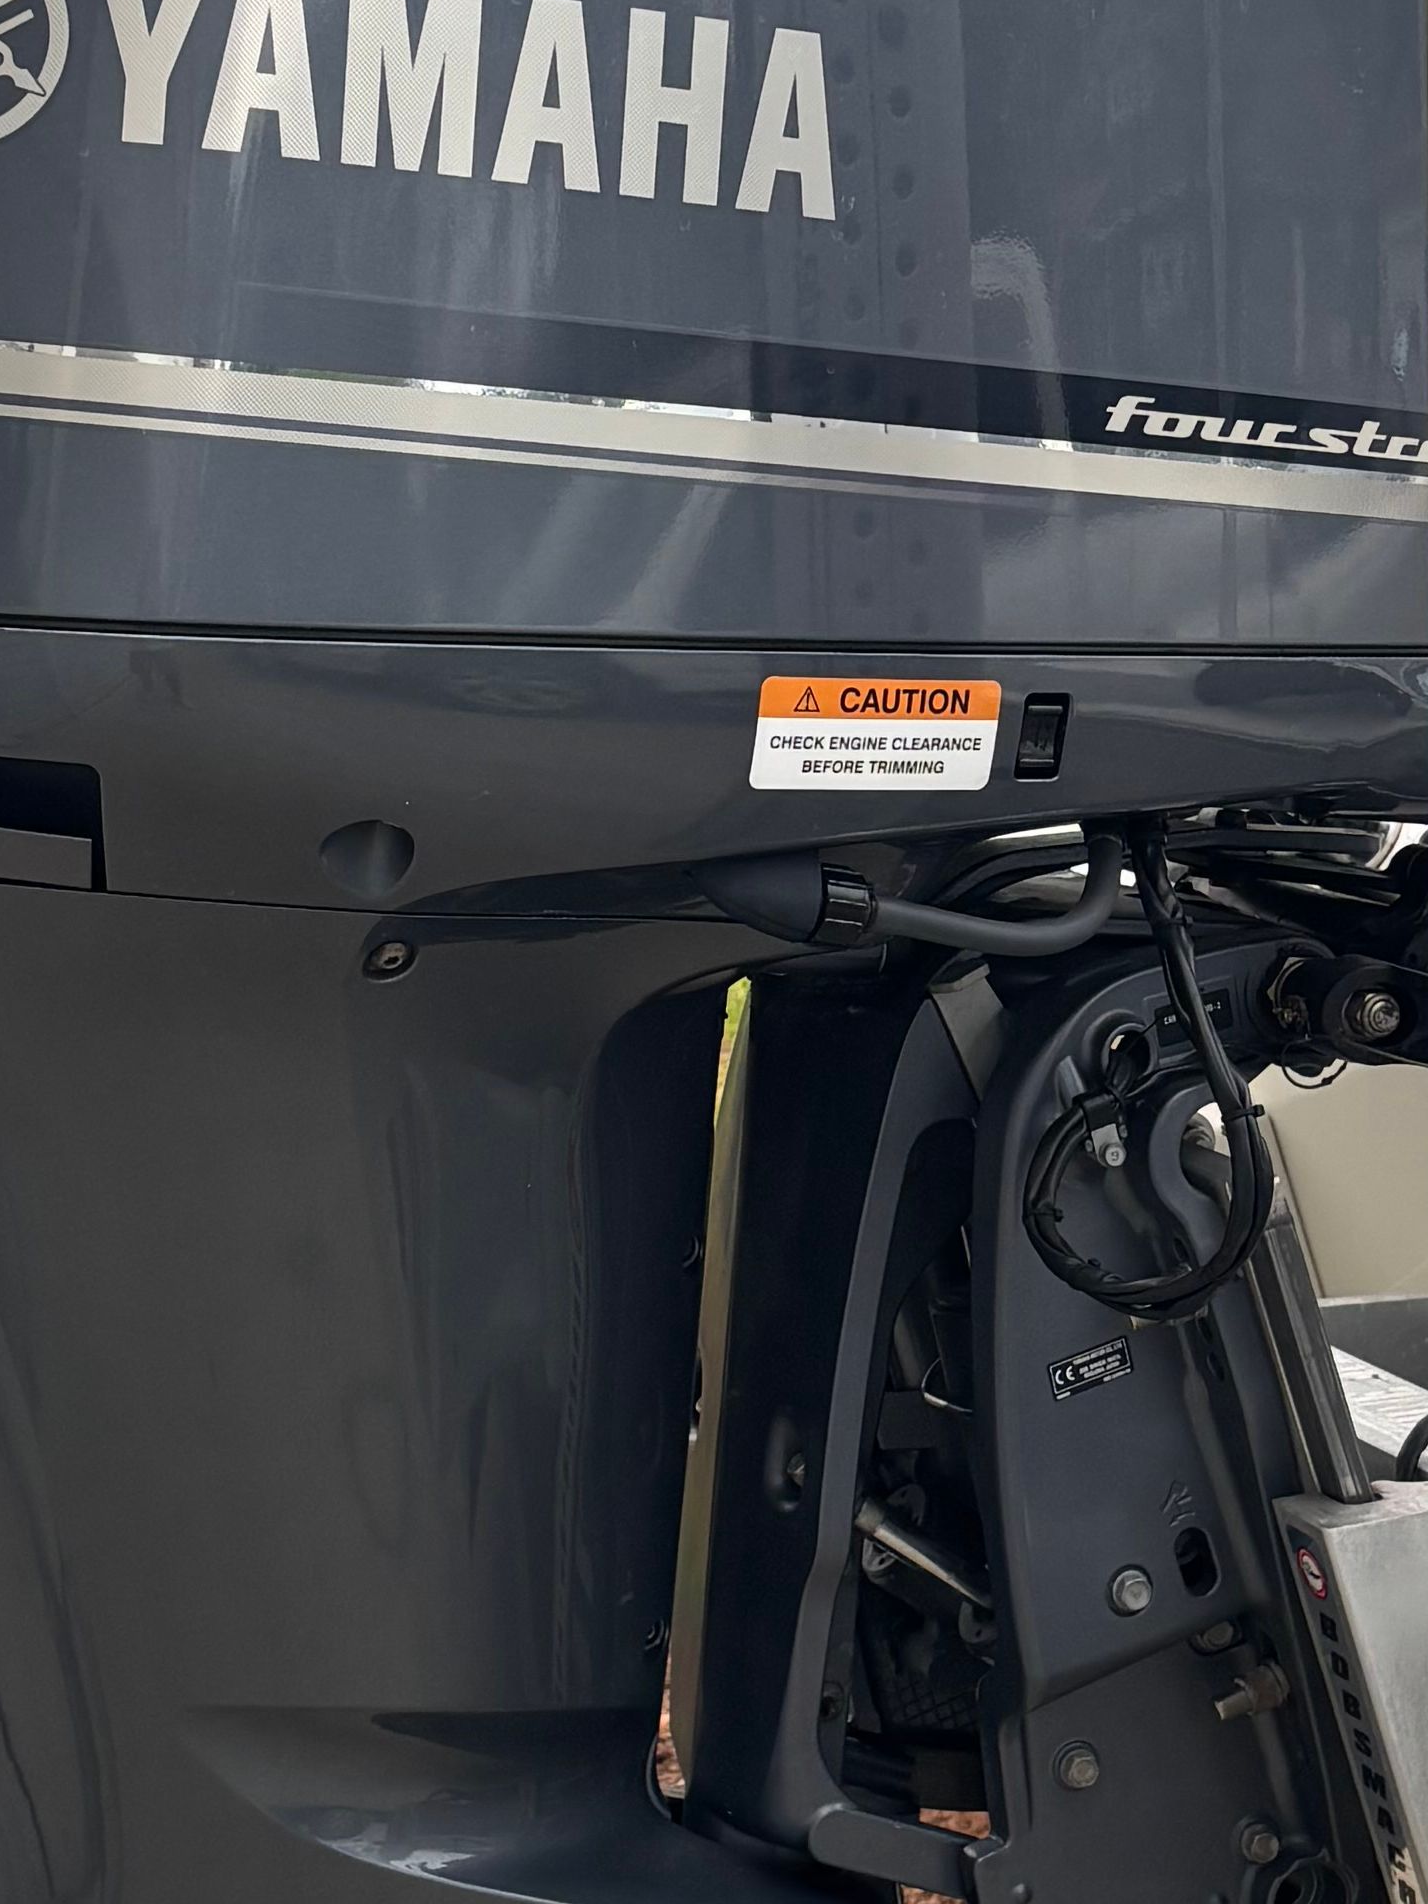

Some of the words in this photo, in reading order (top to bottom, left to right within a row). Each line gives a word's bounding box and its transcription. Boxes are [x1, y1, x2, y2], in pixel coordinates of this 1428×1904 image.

[839, 687, 971, 715] CAUTION
[769, 736, 825, 750] CHECK
[829, 737, 887, 751] ENGINE
[892, 737, 982, 751] CLEARANCE
[802, 760, 865, 774] BEFORE
[869, 760, 945, 775] TRIMMING
